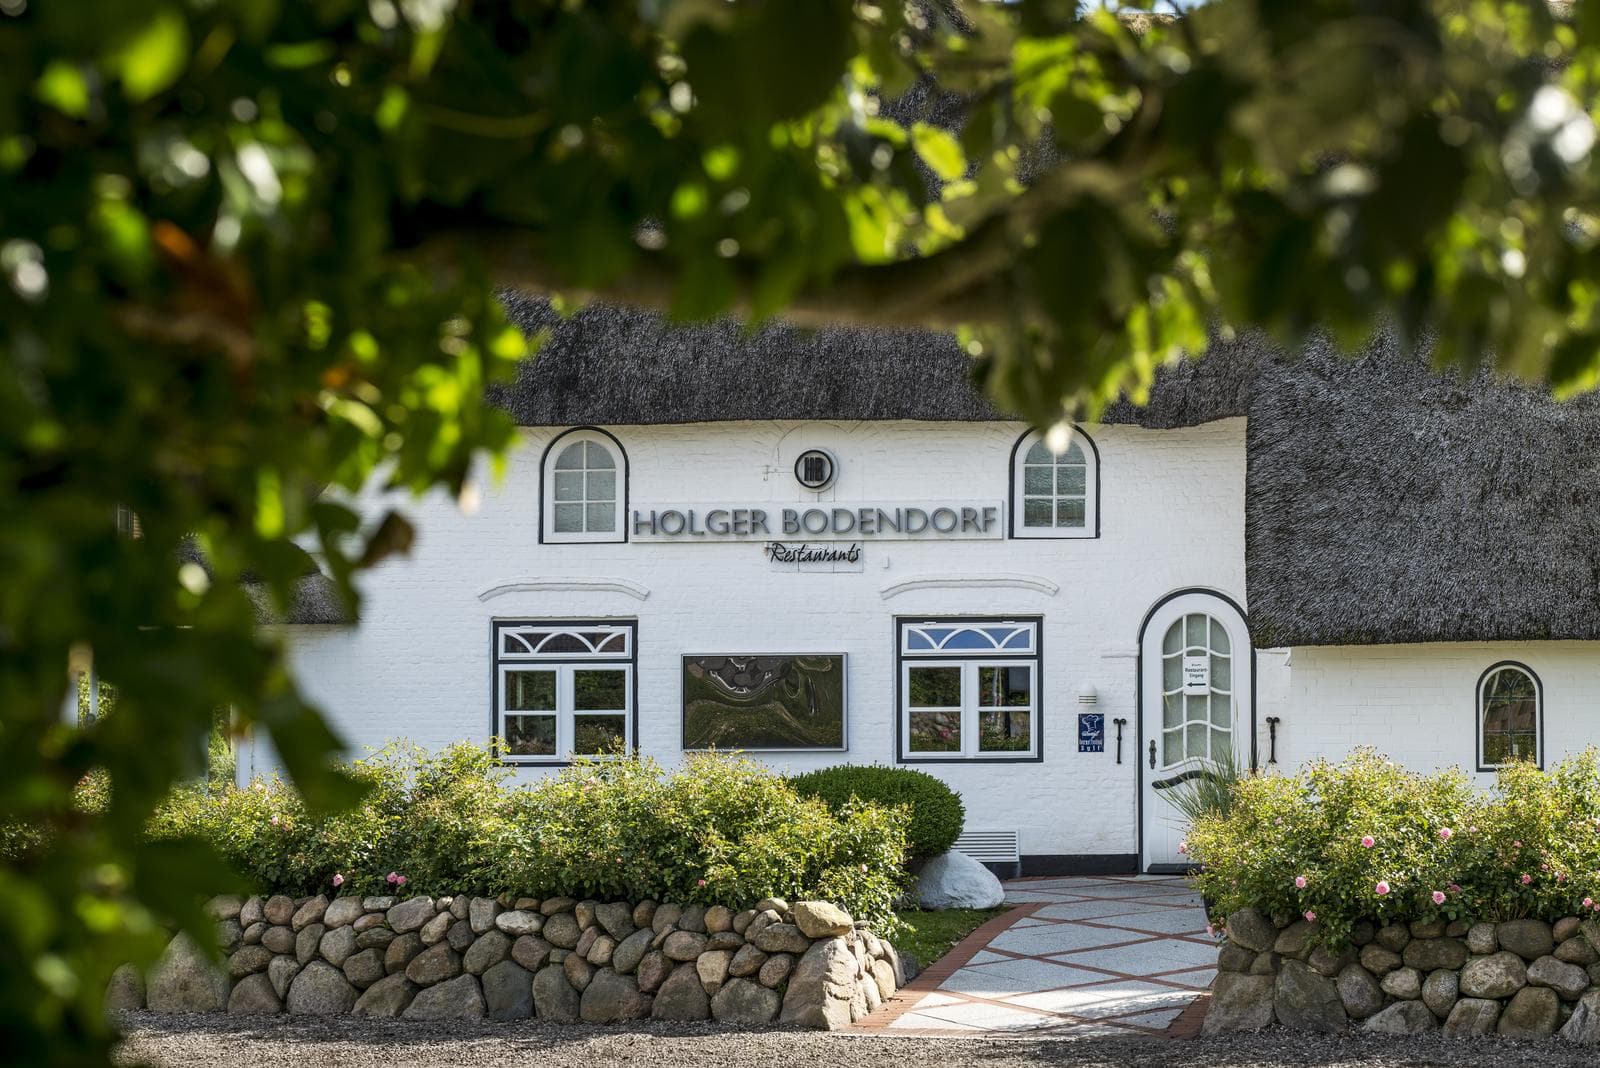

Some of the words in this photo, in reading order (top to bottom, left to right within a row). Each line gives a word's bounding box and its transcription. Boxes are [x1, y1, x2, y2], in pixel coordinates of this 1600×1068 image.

[633, 508, 770, 536] HOLGER
[781, 507, 997, 535] BODENDORF
[771, 542, 861, 563] Restaurants
